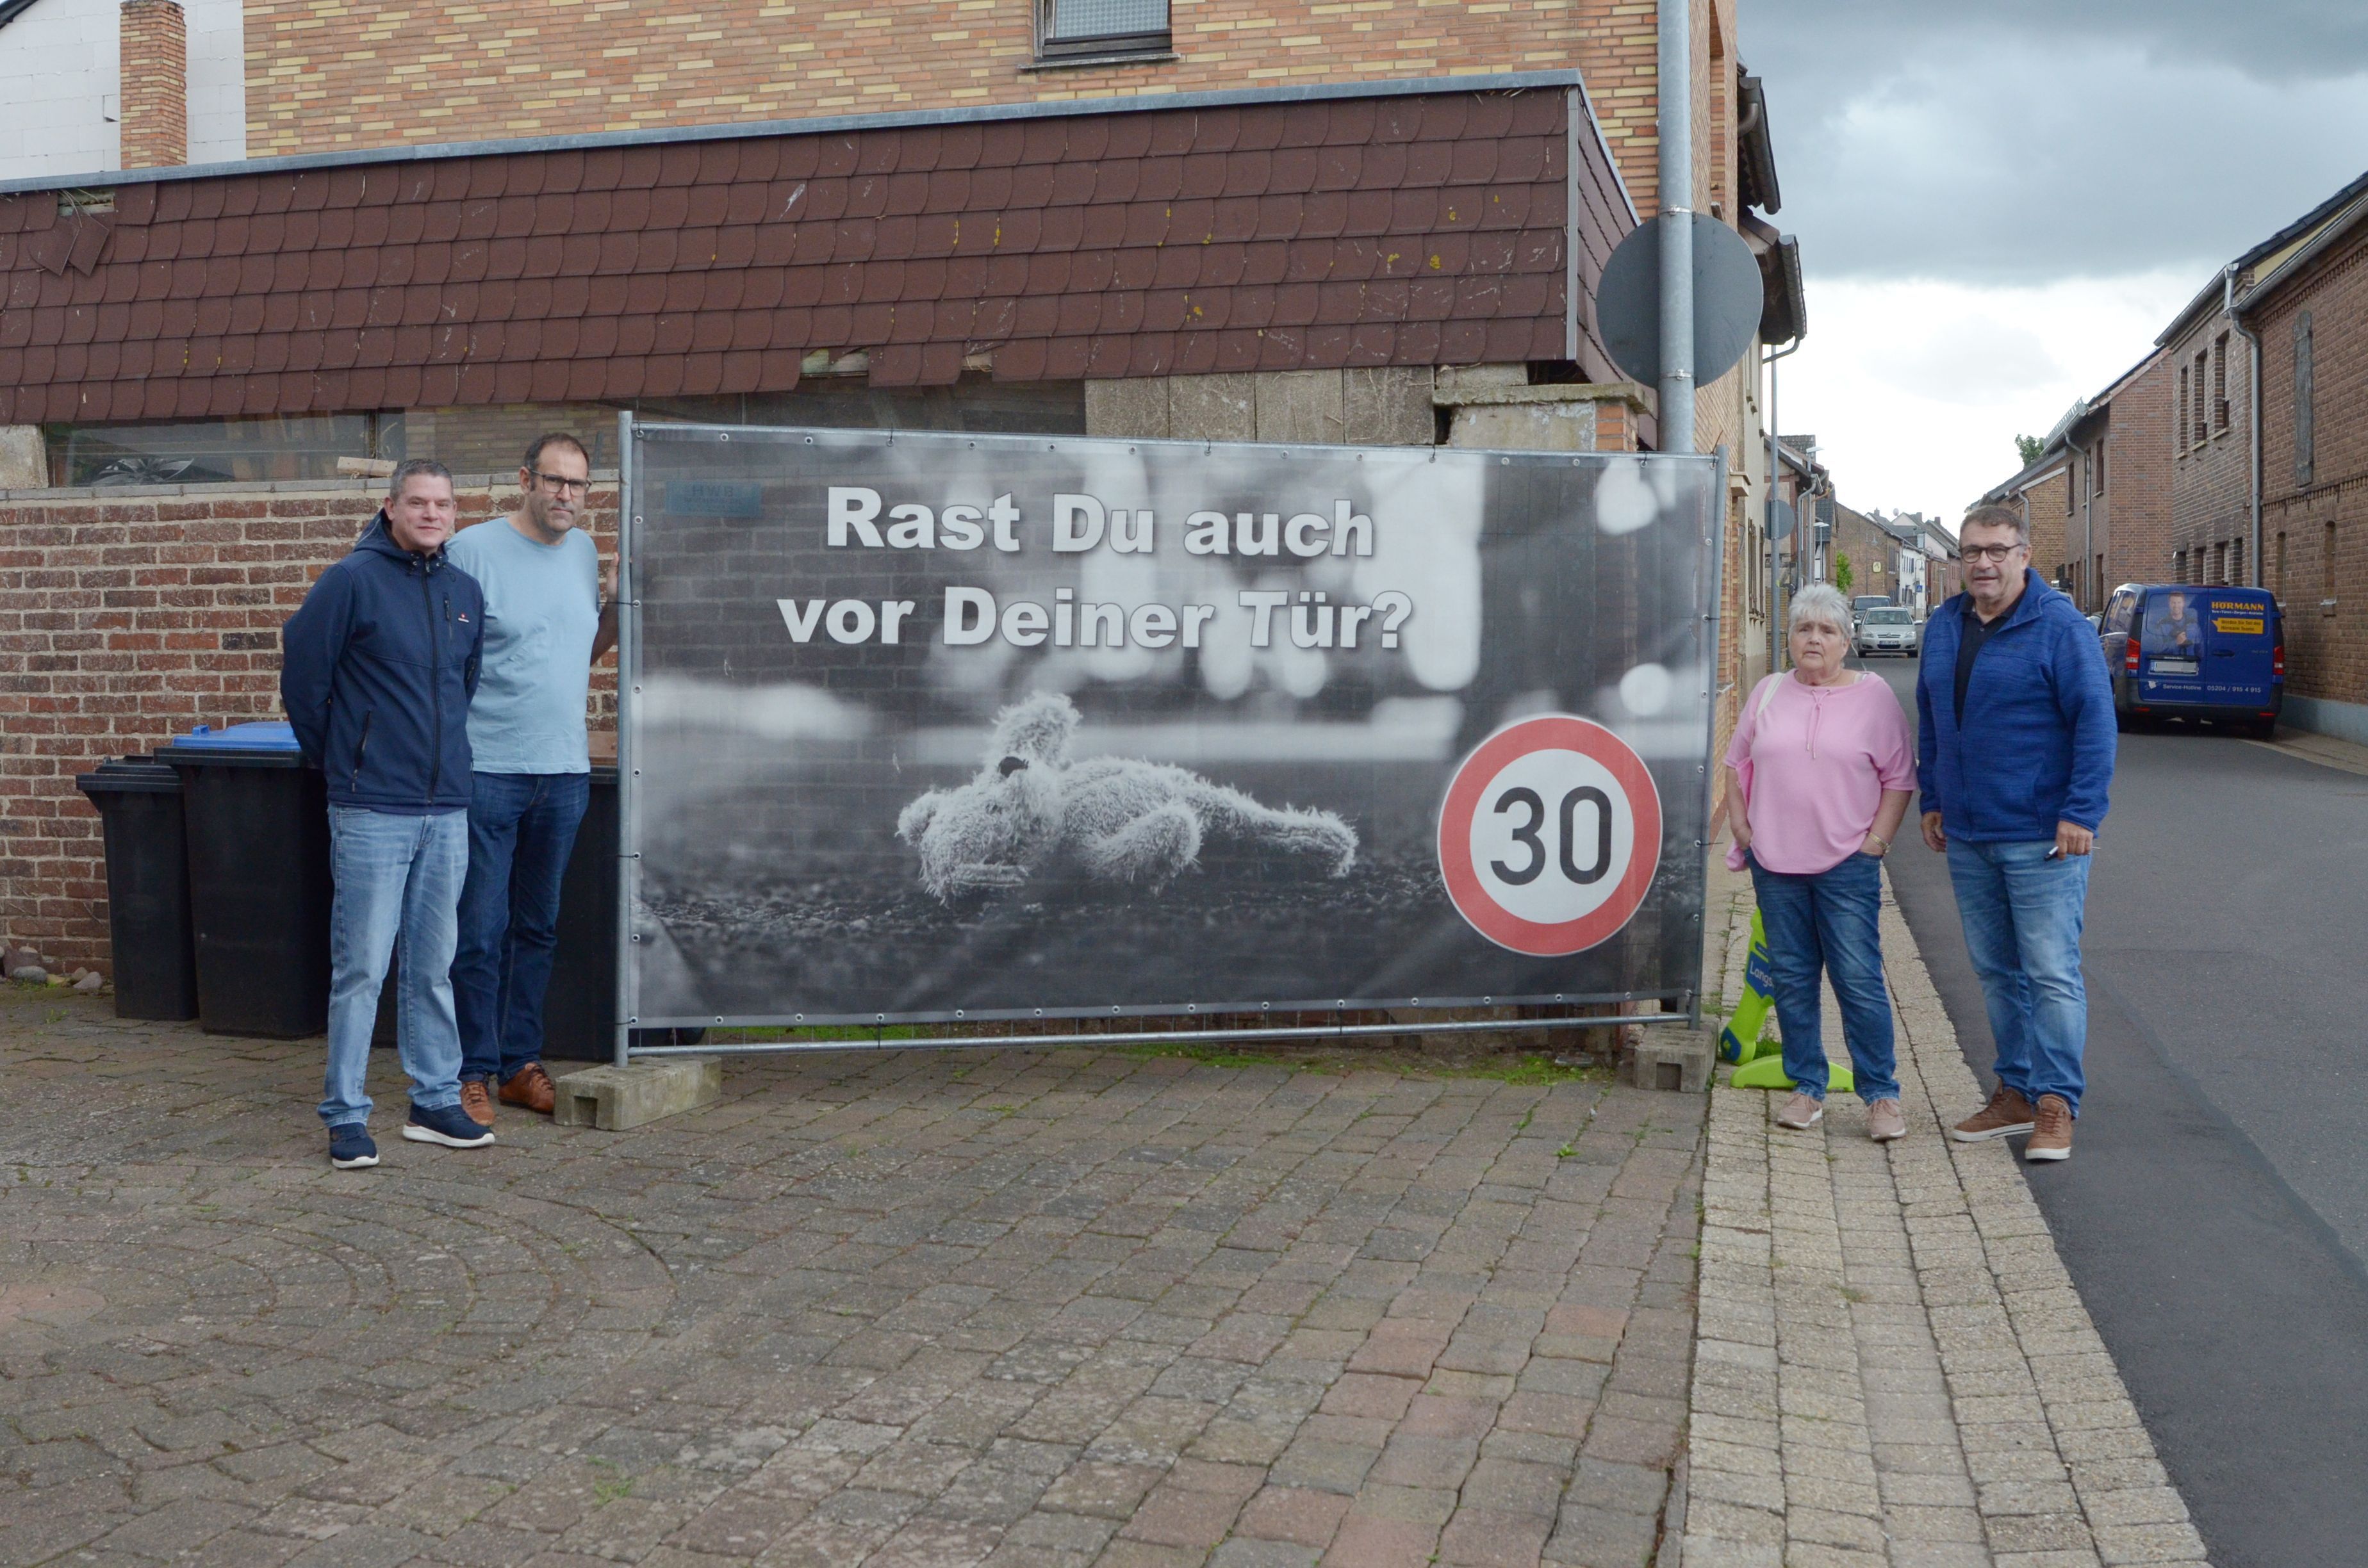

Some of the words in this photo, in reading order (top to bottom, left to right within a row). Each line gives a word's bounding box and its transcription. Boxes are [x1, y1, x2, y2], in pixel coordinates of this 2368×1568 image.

[827, 486, 1020, 552] Rast
[1053, 493, 1154, 553] Du
[1184, 499, 1374, 557] auch
[777, 597, 915, 644] vor
[943, 587, 1215, 648] Deiner
[1238, 590, 1413, 648] Tür?
[1490, 785, 1612, 886] 30
[1750, 960, 1774, 988] Langs
